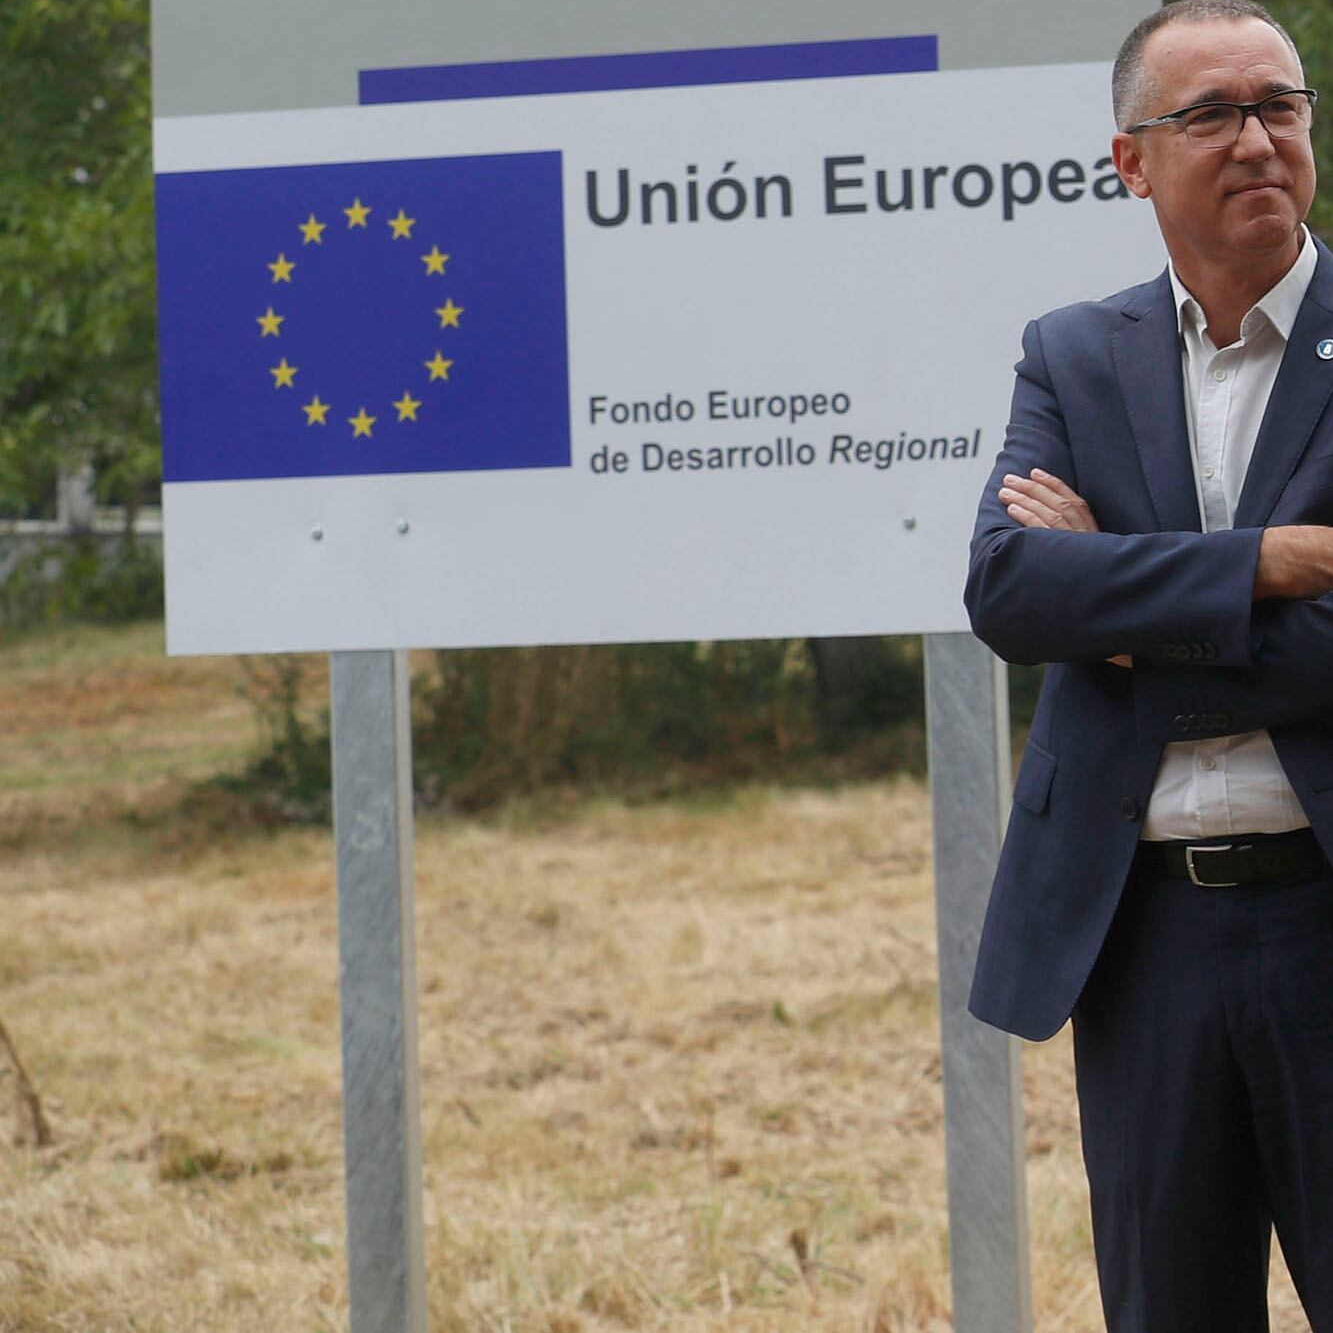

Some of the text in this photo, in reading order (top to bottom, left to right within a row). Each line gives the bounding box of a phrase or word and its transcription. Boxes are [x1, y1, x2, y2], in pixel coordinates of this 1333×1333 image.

[585, 153, 1130, 228] Unión Europea
[589, 390, 851, 425] Fondo Europeo
[589, 428, 981, 475] de Desarrollo Regional
